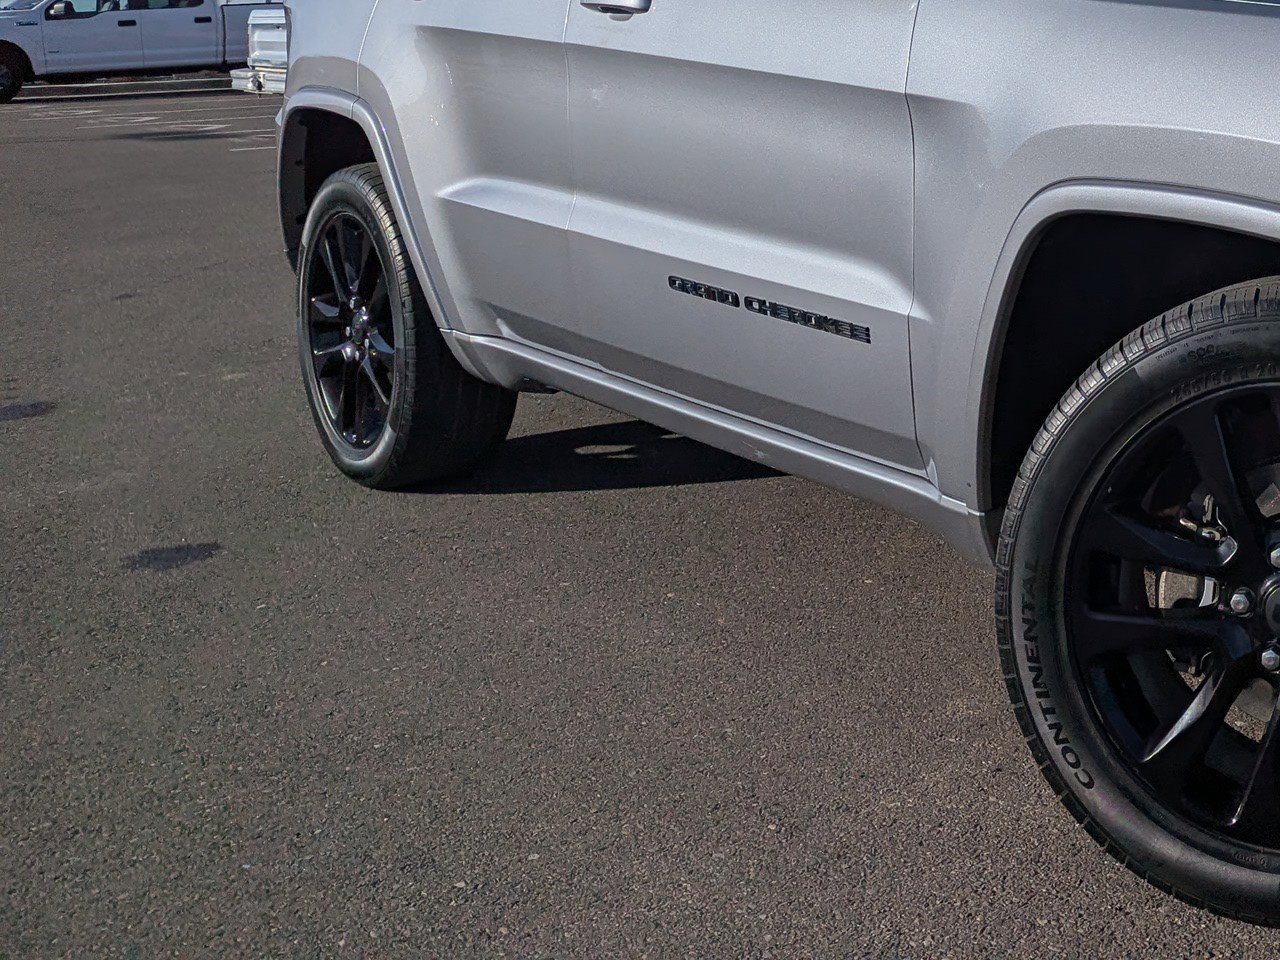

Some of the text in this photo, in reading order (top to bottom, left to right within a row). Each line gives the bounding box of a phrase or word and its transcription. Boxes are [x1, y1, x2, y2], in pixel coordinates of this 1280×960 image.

[668, 275, 872, 345] GRAND CHEROKEE
[1021, 559, 1095, 790] CONTINENTAL
